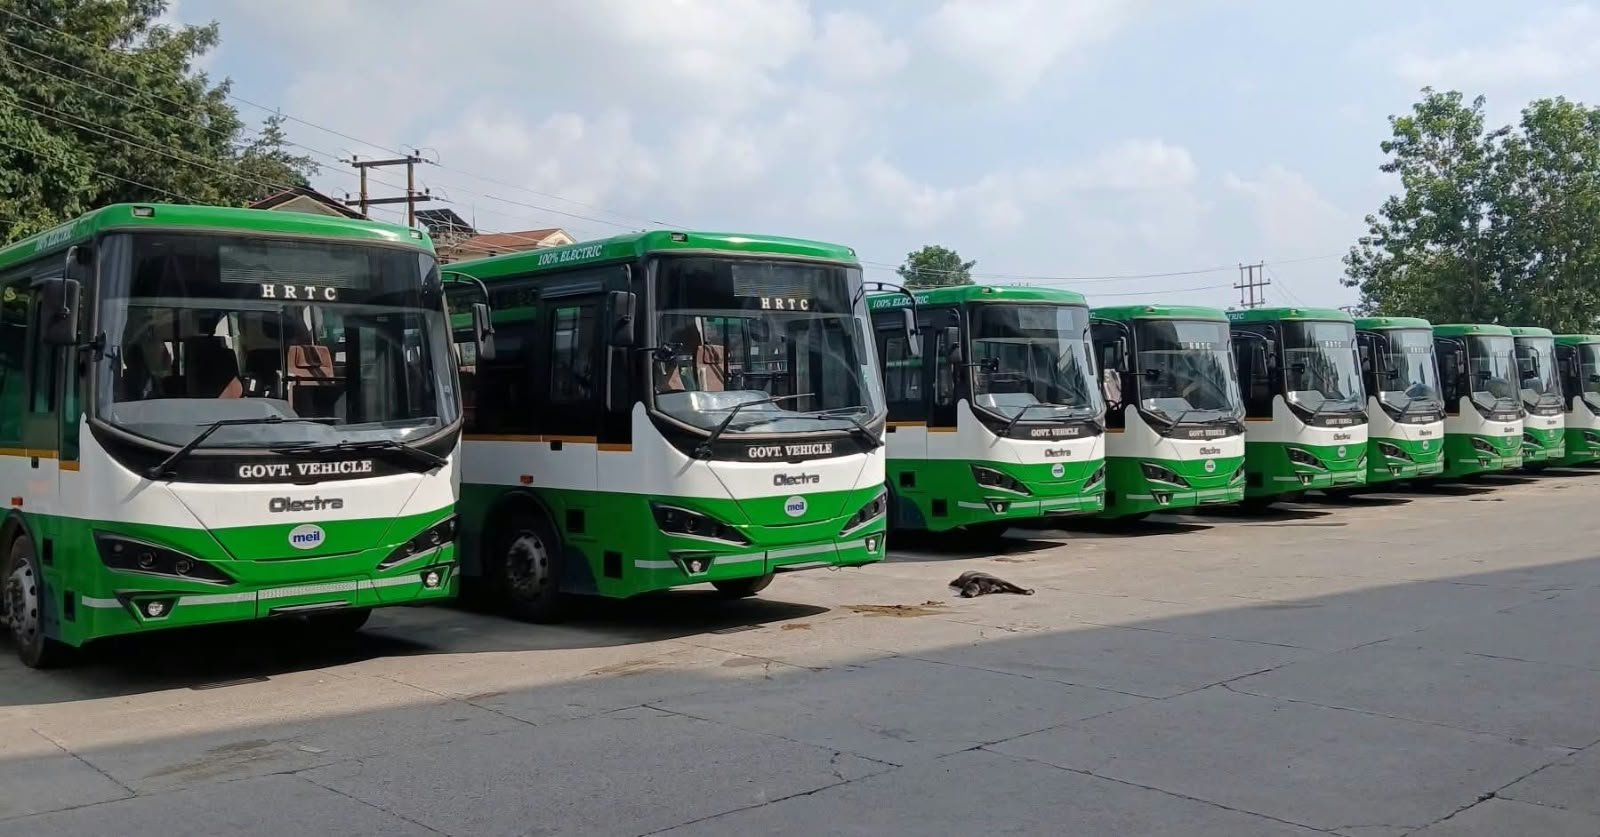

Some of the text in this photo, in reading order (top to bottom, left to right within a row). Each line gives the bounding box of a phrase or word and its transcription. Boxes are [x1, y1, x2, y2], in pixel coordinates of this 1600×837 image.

[560, 244, 603, 262] ELECTRIC
[892, 295, 929, 307] ELECRIC
[748, 443, 833, 459] GOVT. VEHICLE
[238, 460, 373, 478] GOVT. VEHICLE
[773, 472, 820, 487] Olectra
[268, 495, 344, 513] Olectra
[292, 530, 320, 543] meil
